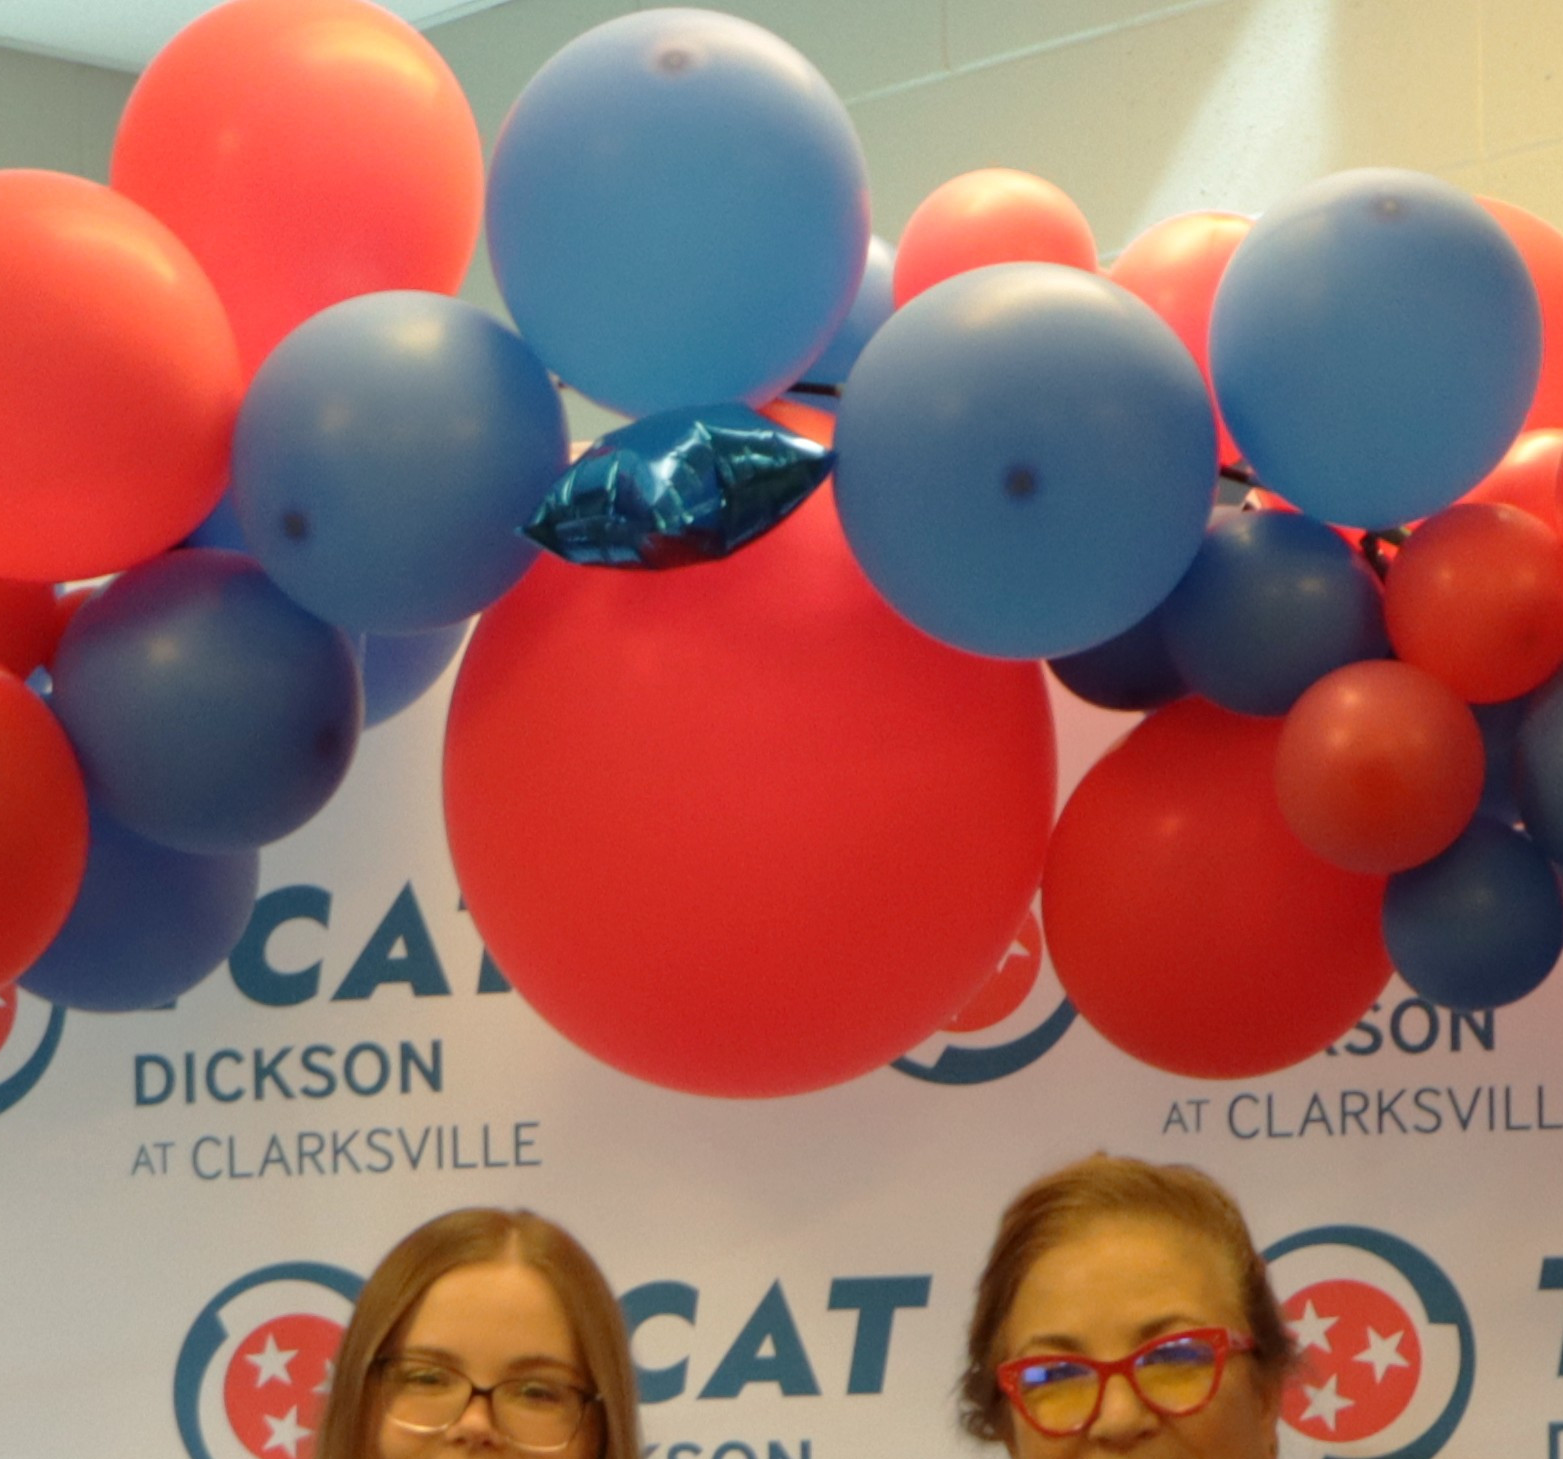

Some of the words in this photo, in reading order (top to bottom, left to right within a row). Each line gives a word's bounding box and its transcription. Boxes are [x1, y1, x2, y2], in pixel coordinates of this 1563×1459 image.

[152, 879, 514, 1010] CA
[134, 1039, 445, 1108] DICKSON
[130, 1143, 176, 1177] AT
[190, 1121, 543, 1181] CLARKSVILLE
[1161, 1099, 1211, 1136] AT
[615, 1273, 934, 1406] CAT
